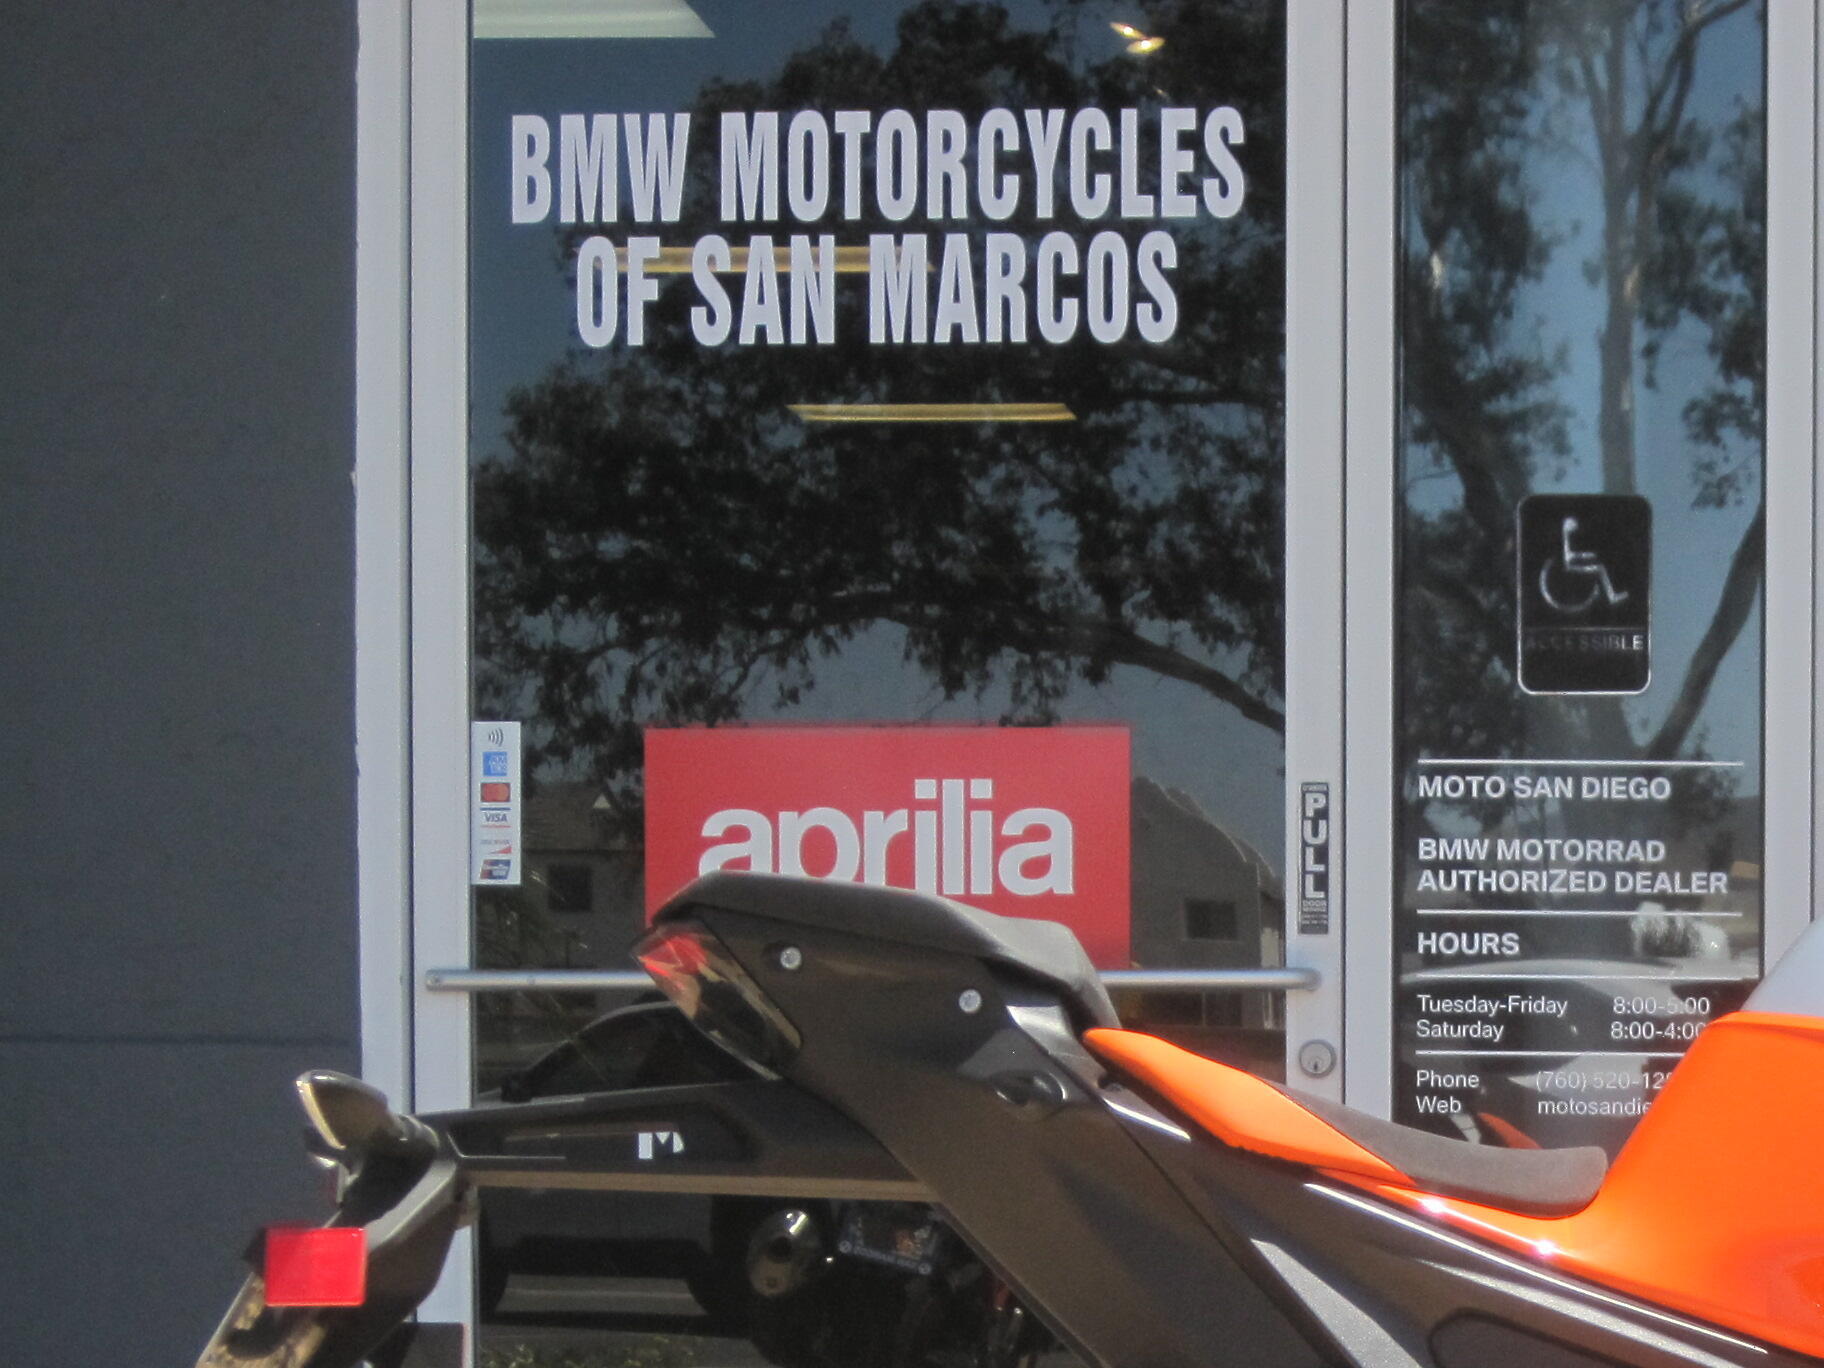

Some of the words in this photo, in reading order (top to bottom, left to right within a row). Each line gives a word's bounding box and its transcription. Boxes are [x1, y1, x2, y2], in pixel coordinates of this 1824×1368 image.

[511, 112, 690, 225] BMW
[720, 106, 1246, 221] MOTORCYCLES
[574, 235, 661, 348] OF
[689, 233, 837, 347] SAN
[868, 230, 1179, 345] MARCOS
[1417, 775, 1506, 799] MOTO
[1513, 776, 1573, 799] SAN
[1581, 776, 1672, 801] DIEGO
[484, 813, 508, 823] VISA
[699, 778, 1075, 897] aprilia
[1302, 792, 1328, 899] PULL
[1417, 837, 1489, 861] BMW
[1497, 839, 1666, 862] MOTORRAD
[1416, 869, 1606, 893] AUTHORIZED
[1614, 871, 1728, 894] DEALER
[1416, 931, 1520, 955] HOURS
[1416, 994, 1568, 1018] Tuesday-Friday
[1613, 996, 1711, 1014] 8:00-5:00
[1416, 1020, 1504, 1042] Saturday
[1416, 1069, 1480, 1089] Phone
[1536, 1071, 1587, 1092] (760)
[1592, 1072, 1673, 1090] 520-12
[1416, 1096, 1461, 1113] Web
